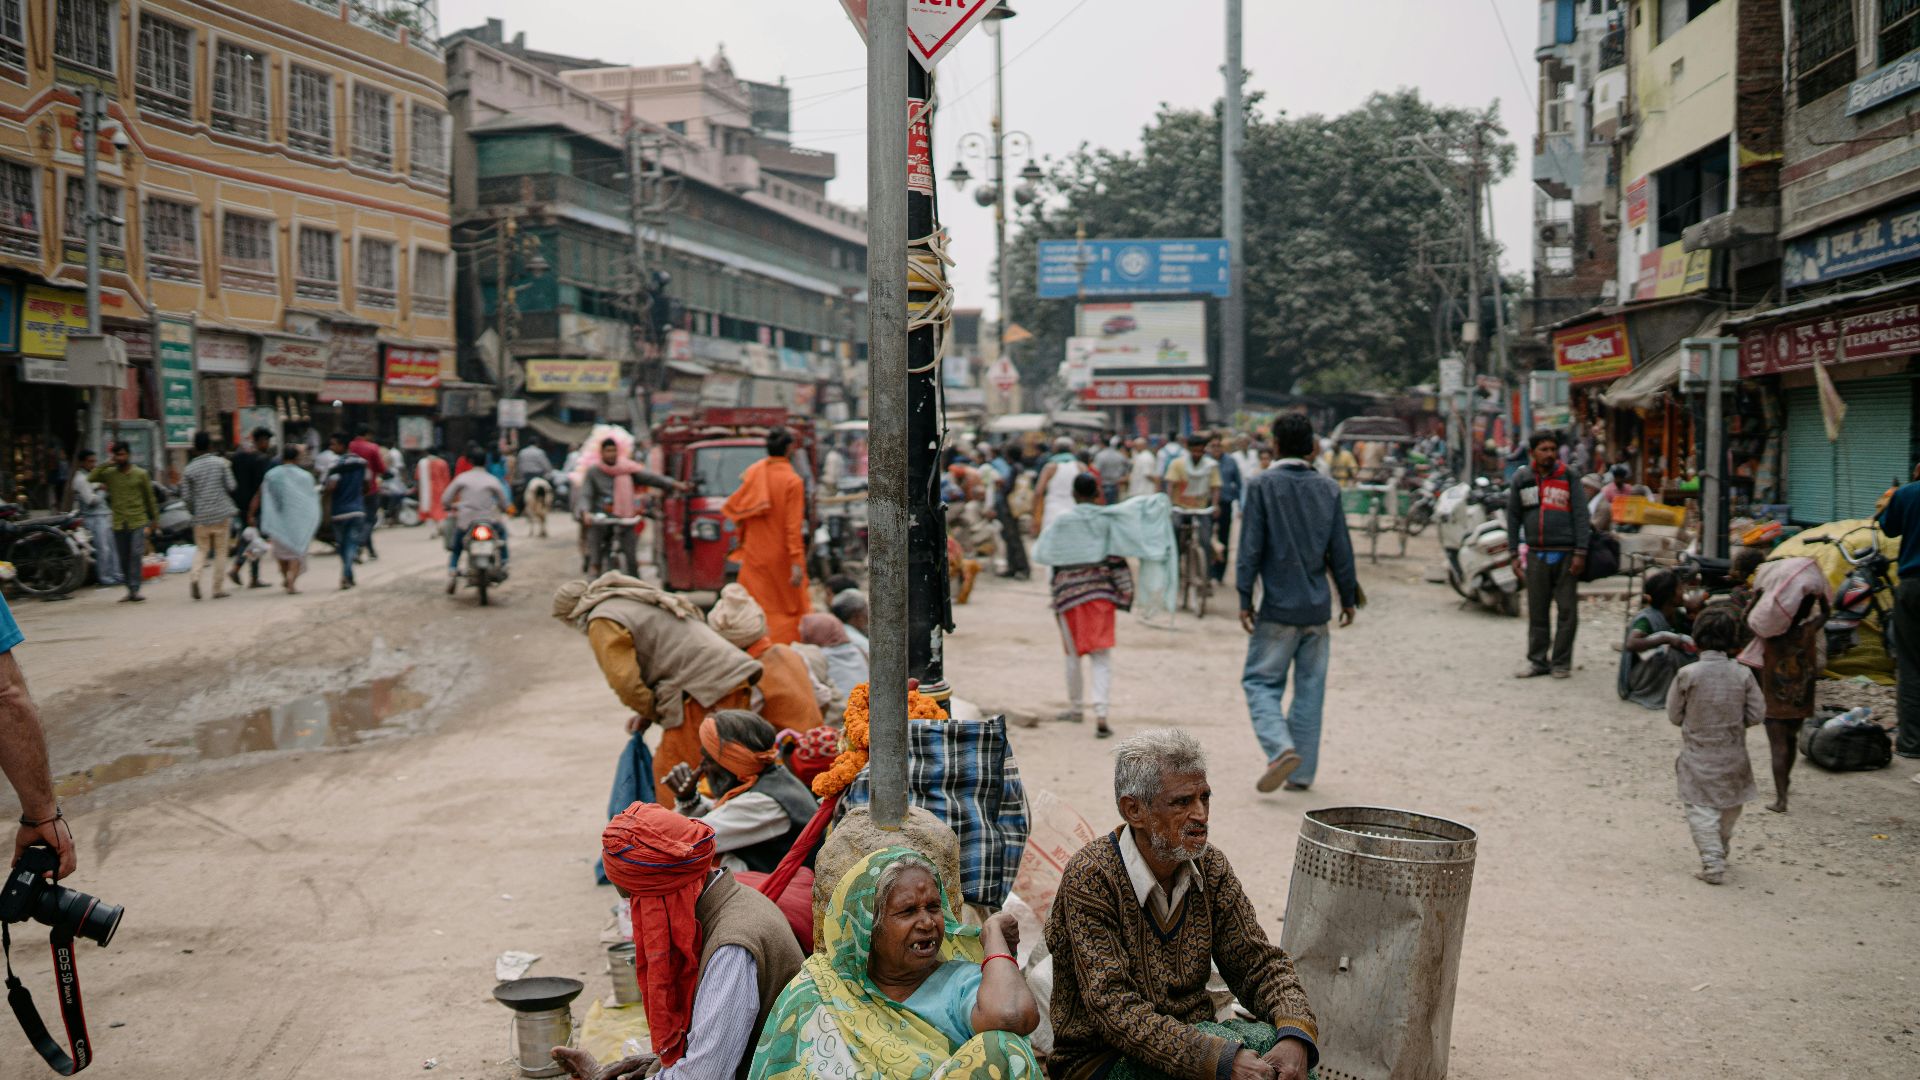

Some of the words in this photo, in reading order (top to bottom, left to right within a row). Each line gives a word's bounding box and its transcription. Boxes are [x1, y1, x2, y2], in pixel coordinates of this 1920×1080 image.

[1827, 323, 1919, 351] ETERPRISES
[58, 948, 71, 971] EOS
[62, 973, 73, 984] 5D
